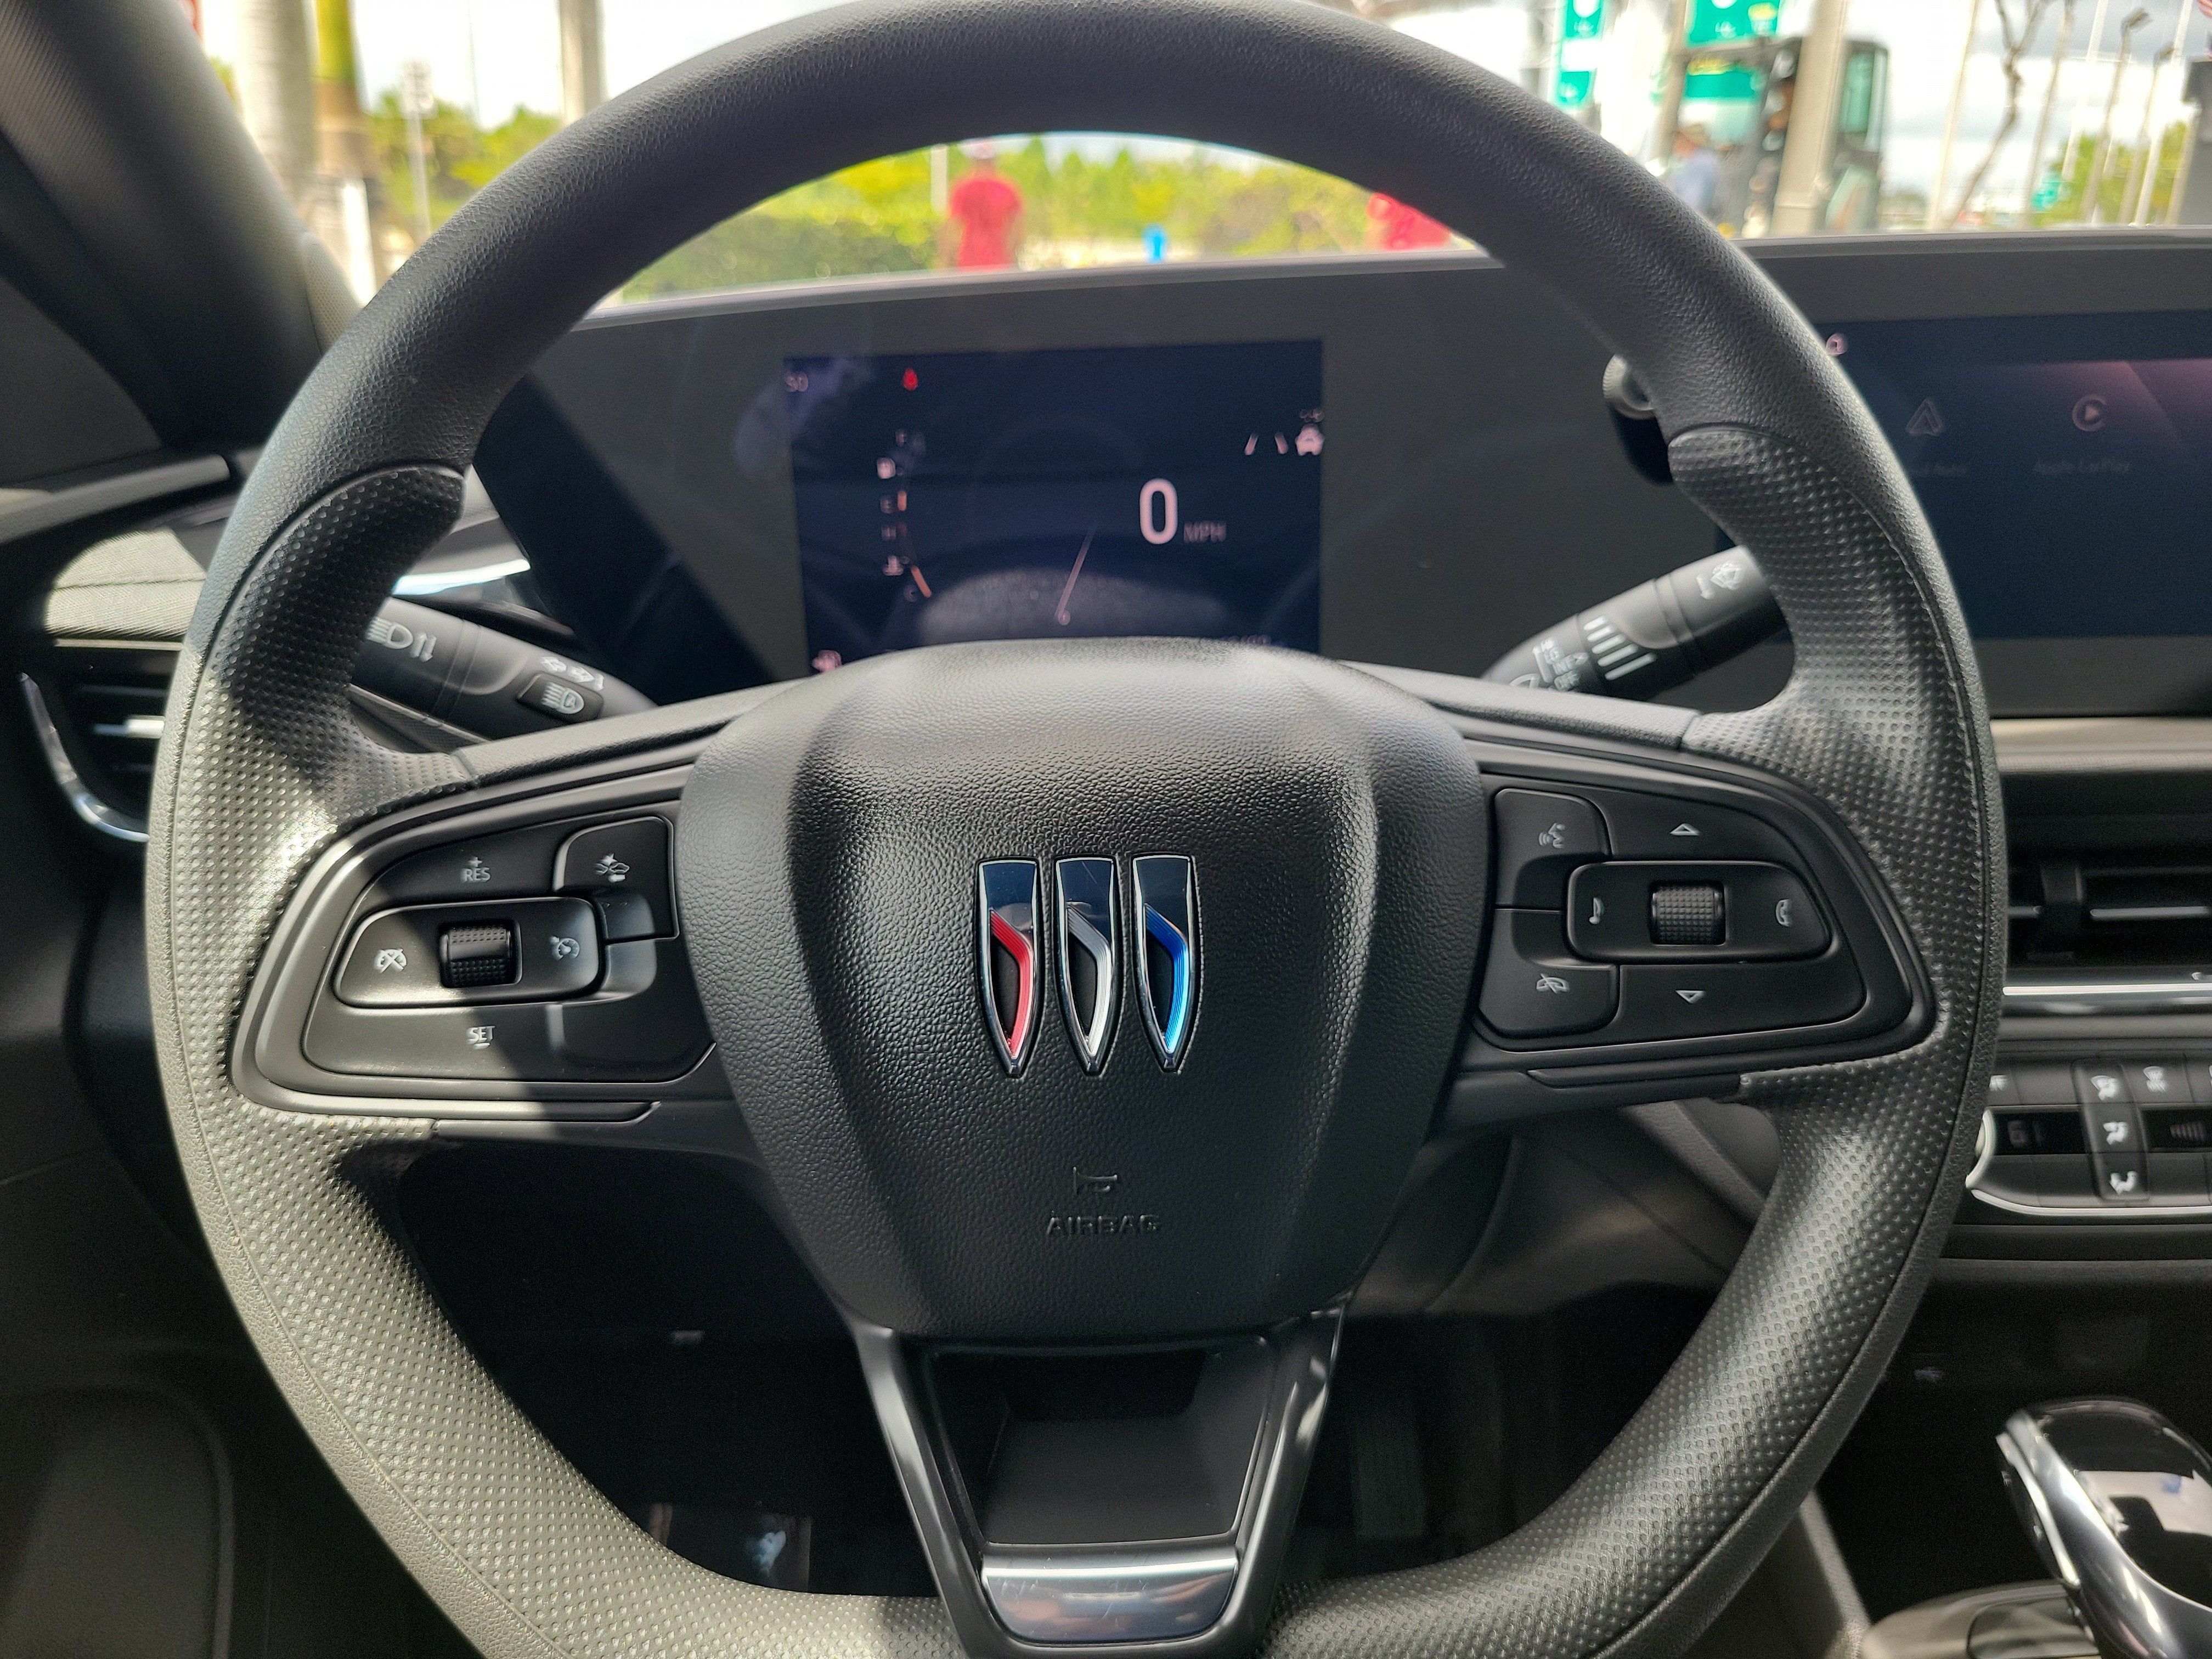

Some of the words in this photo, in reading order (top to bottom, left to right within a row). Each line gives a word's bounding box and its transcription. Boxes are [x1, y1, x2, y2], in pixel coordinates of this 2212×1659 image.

[1139, 478, 1178, 545] 0
[1183, 522, 1226, 543] MPH
[461, 867, 491, 882] RES
[467, 1025, 495, 1044] SET
[1046, 1214, 1160, 1235] AIRBAG
